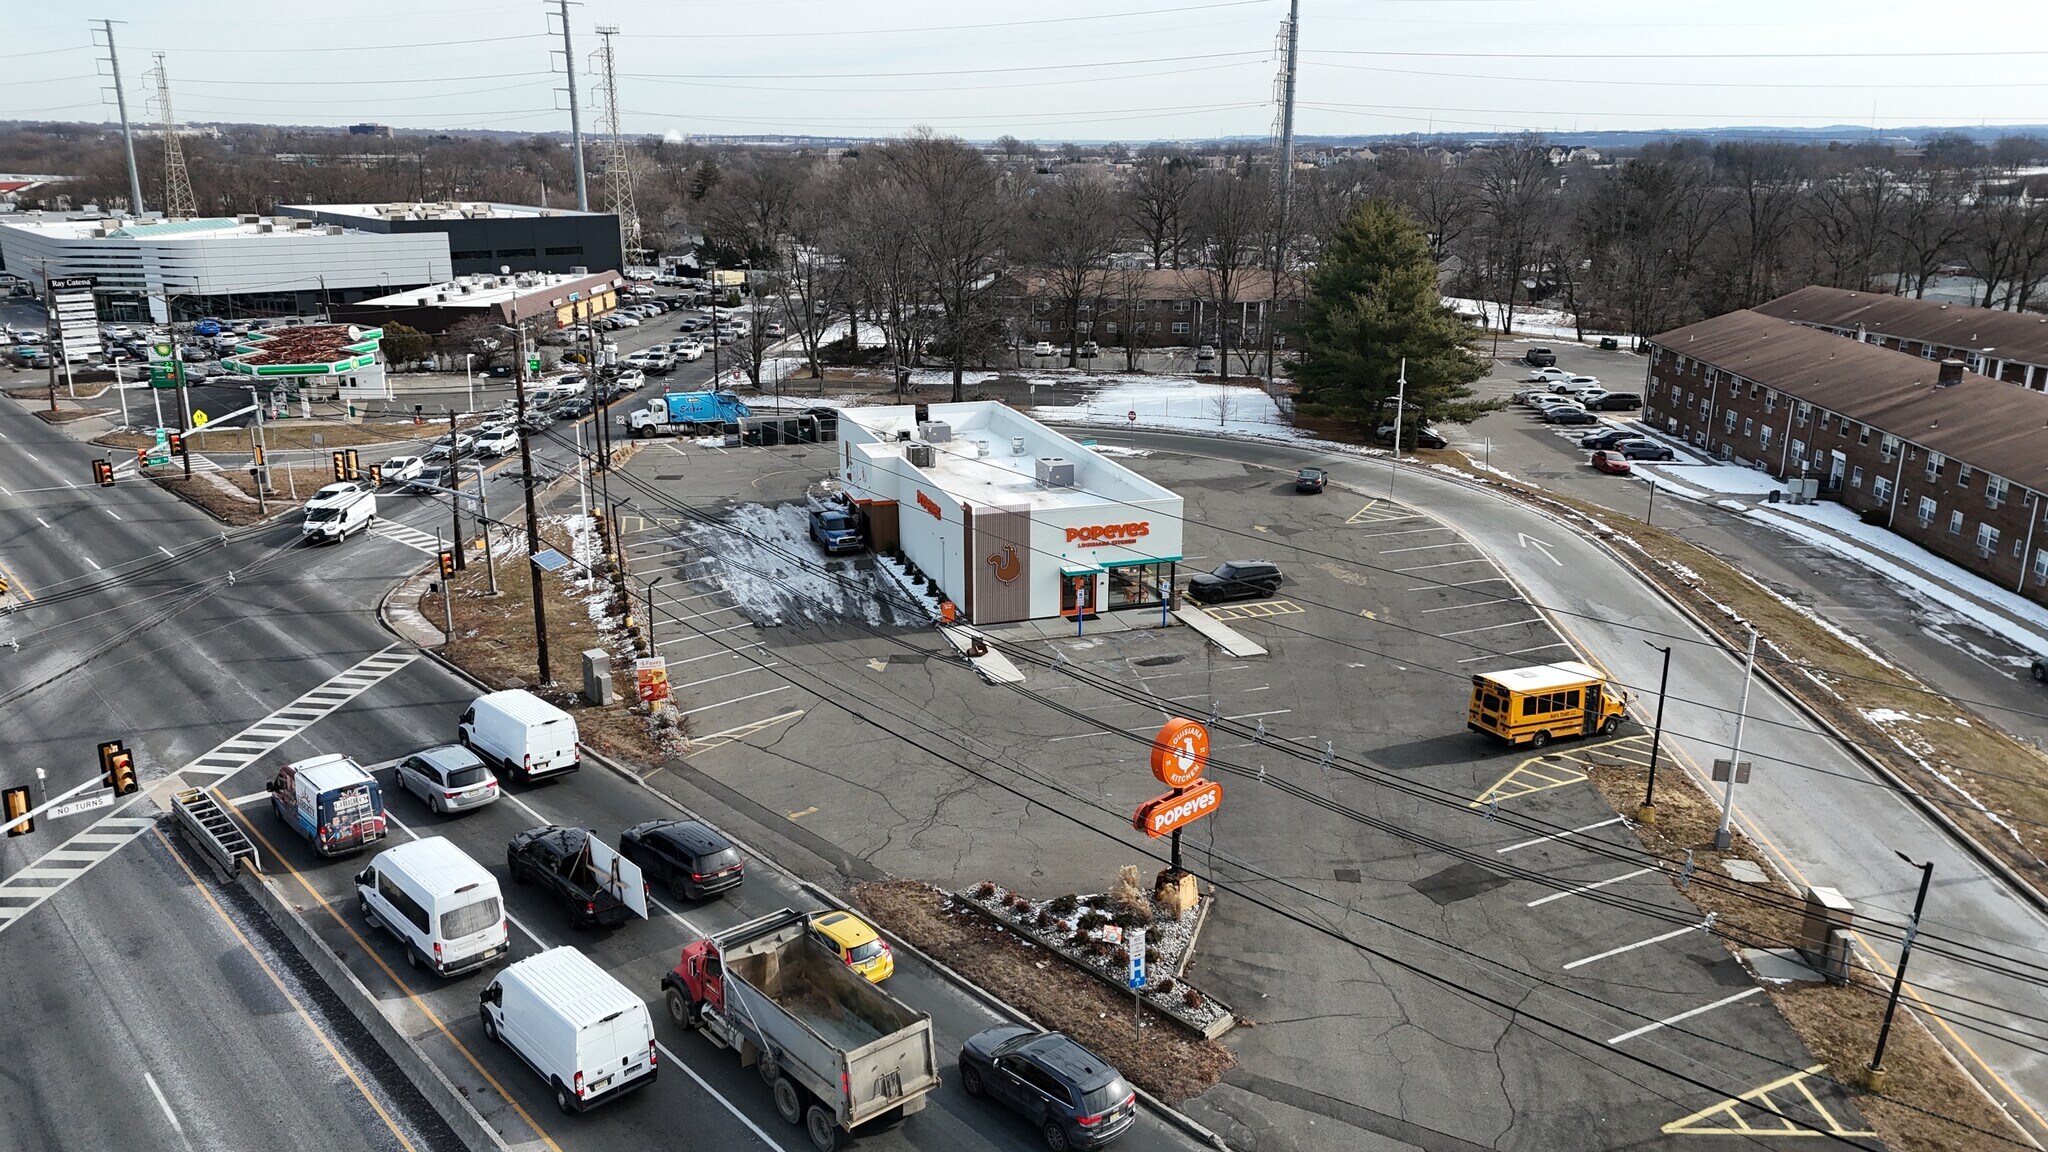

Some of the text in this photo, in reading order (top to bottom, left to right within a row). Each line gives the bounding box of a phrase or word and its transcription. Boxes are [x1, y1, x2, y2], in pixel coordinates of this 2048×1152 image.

[51, 279, 91, 288] Ray Catena
[1077, 538, 1137, 549] LOUISIANA KITCHEN
[1170, 763, 1200, 783] KITCHEN
[57, 798, 104, 815] NO TURNS
